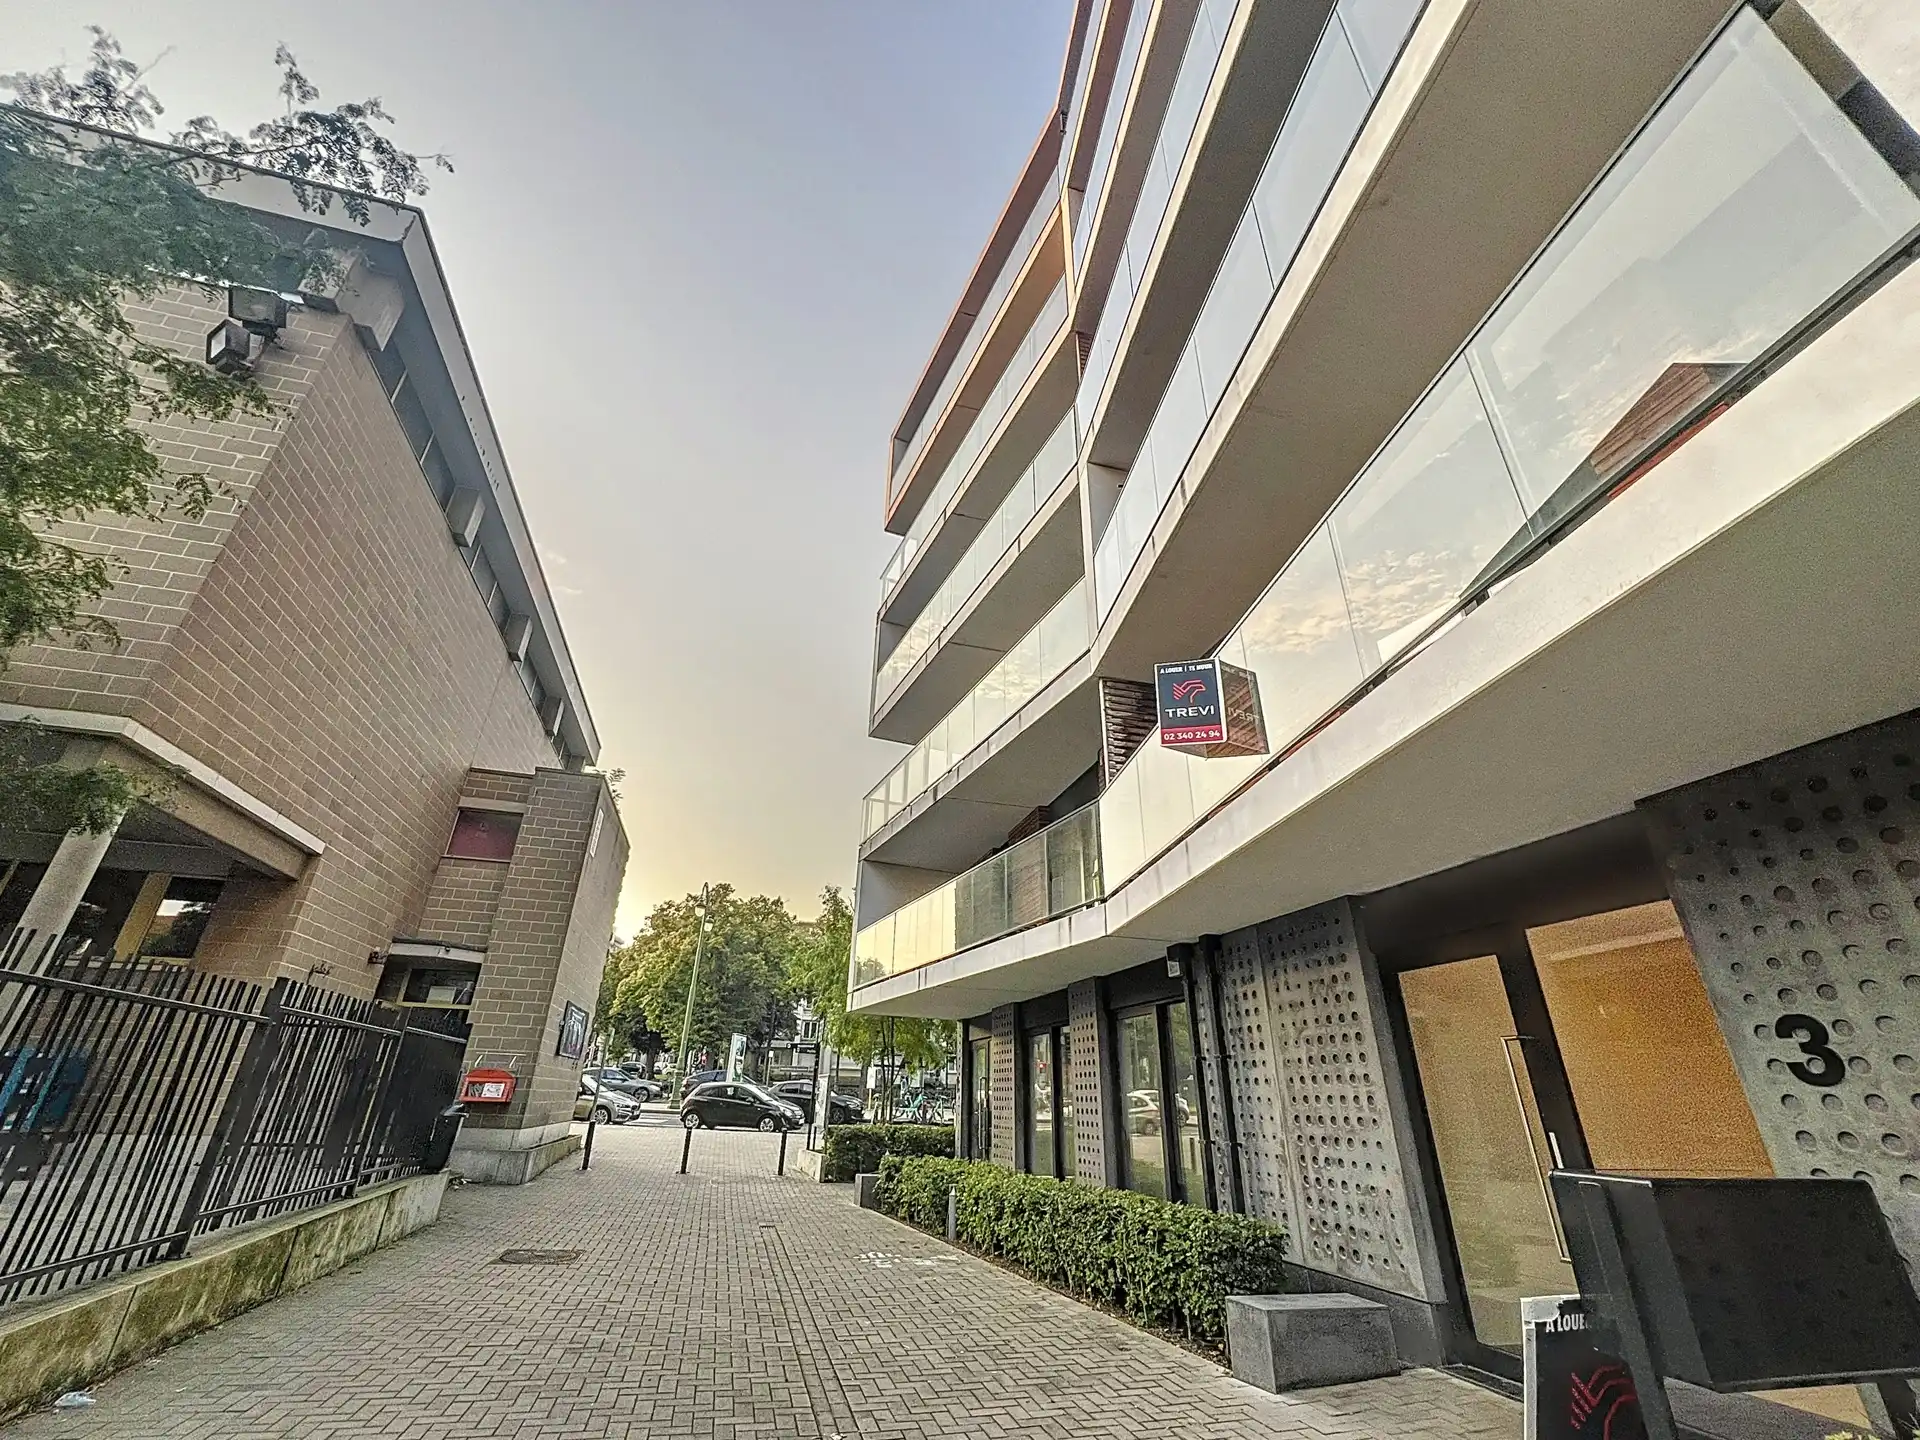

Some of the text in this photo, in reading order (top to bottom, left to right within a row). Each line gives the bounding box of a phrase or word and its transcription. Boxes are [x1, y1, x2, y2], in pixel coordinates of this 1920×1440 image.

[1165, 705, 1215, 718] TREVI
[1163, 729, 1220, 741] 02 340 24 94
[1775, 1014, 1846, 1087] 3
[1557, 1313, 1589, 1332] LOUE
